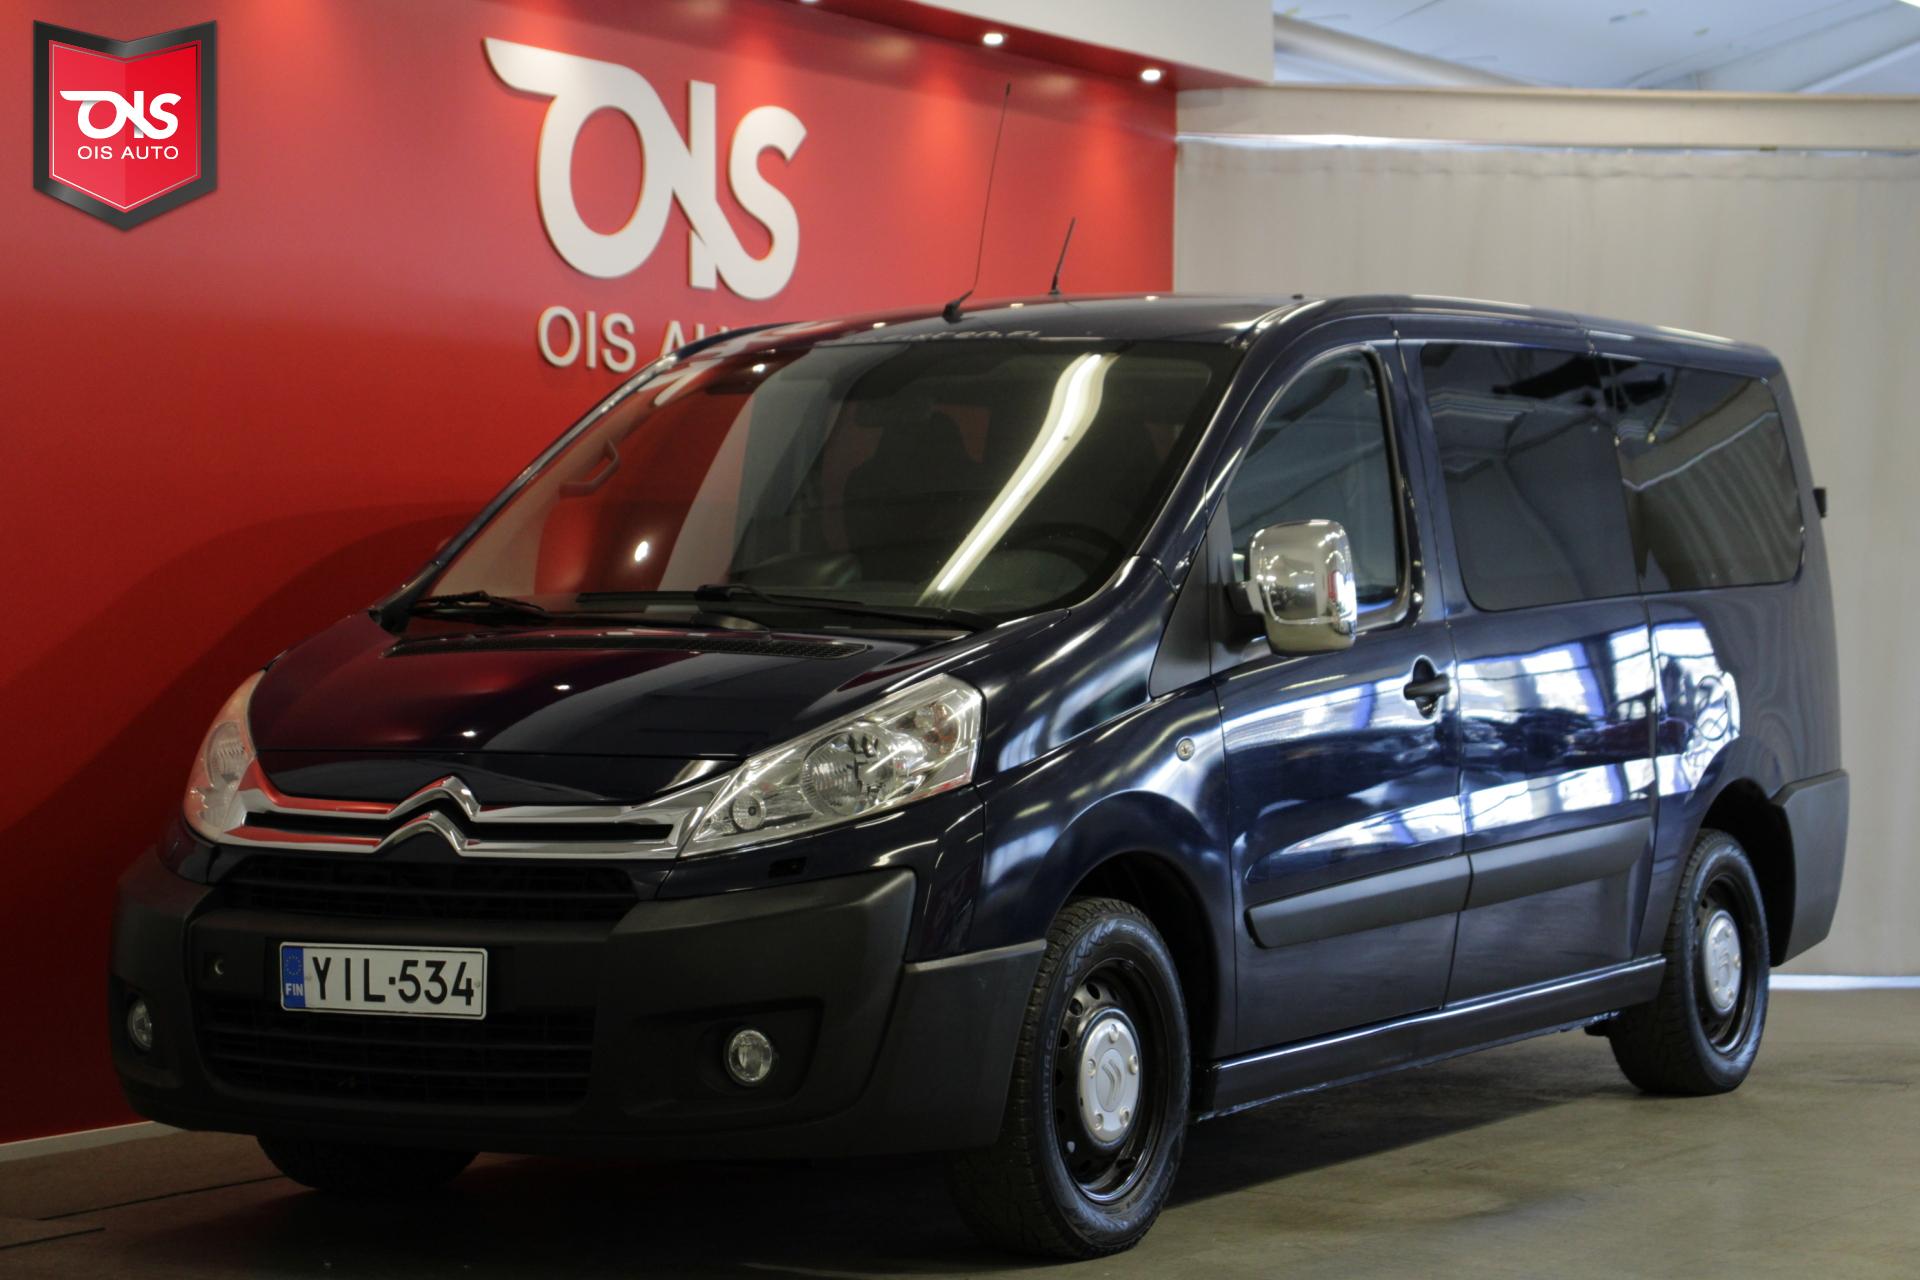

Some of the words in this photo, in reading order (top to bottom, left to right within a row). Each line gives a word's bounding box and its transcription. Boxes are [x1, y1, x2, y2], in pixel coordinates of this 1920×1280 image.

[538, 305, 637, 374] OIS
[285, 983, 304, 997] FIN
[312, 956, 474, 1006] YIL-534
